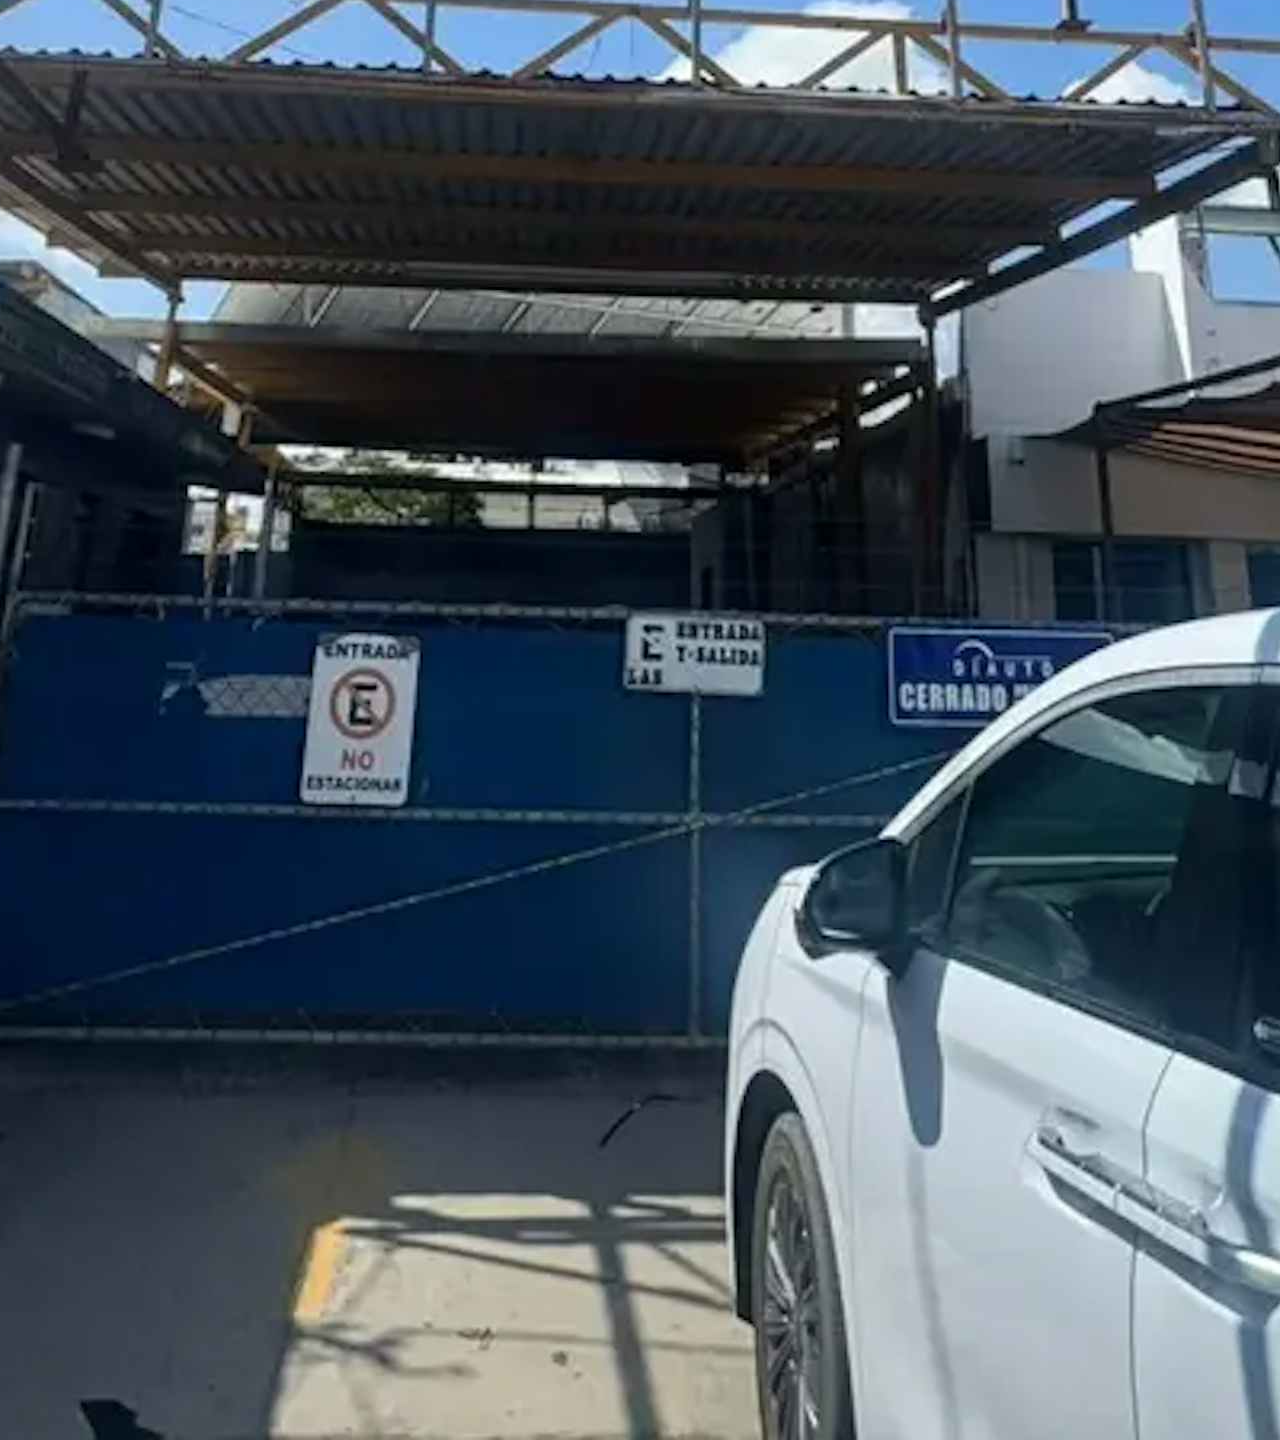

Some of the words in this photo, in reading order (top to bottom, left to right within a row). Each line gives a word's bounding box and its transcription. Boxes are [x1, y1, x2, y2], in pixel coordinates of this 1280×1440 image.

[676, 621, 761, 640] ENTRADA
[323, 642, 411, 660] ENTRADA
[627, 668, 663, 686] LAS
[897, 682, 1009, 712] CERRADO
[341, 749, 376, 772] NO
[306, 775, 403, 792] ESTACIONAR
